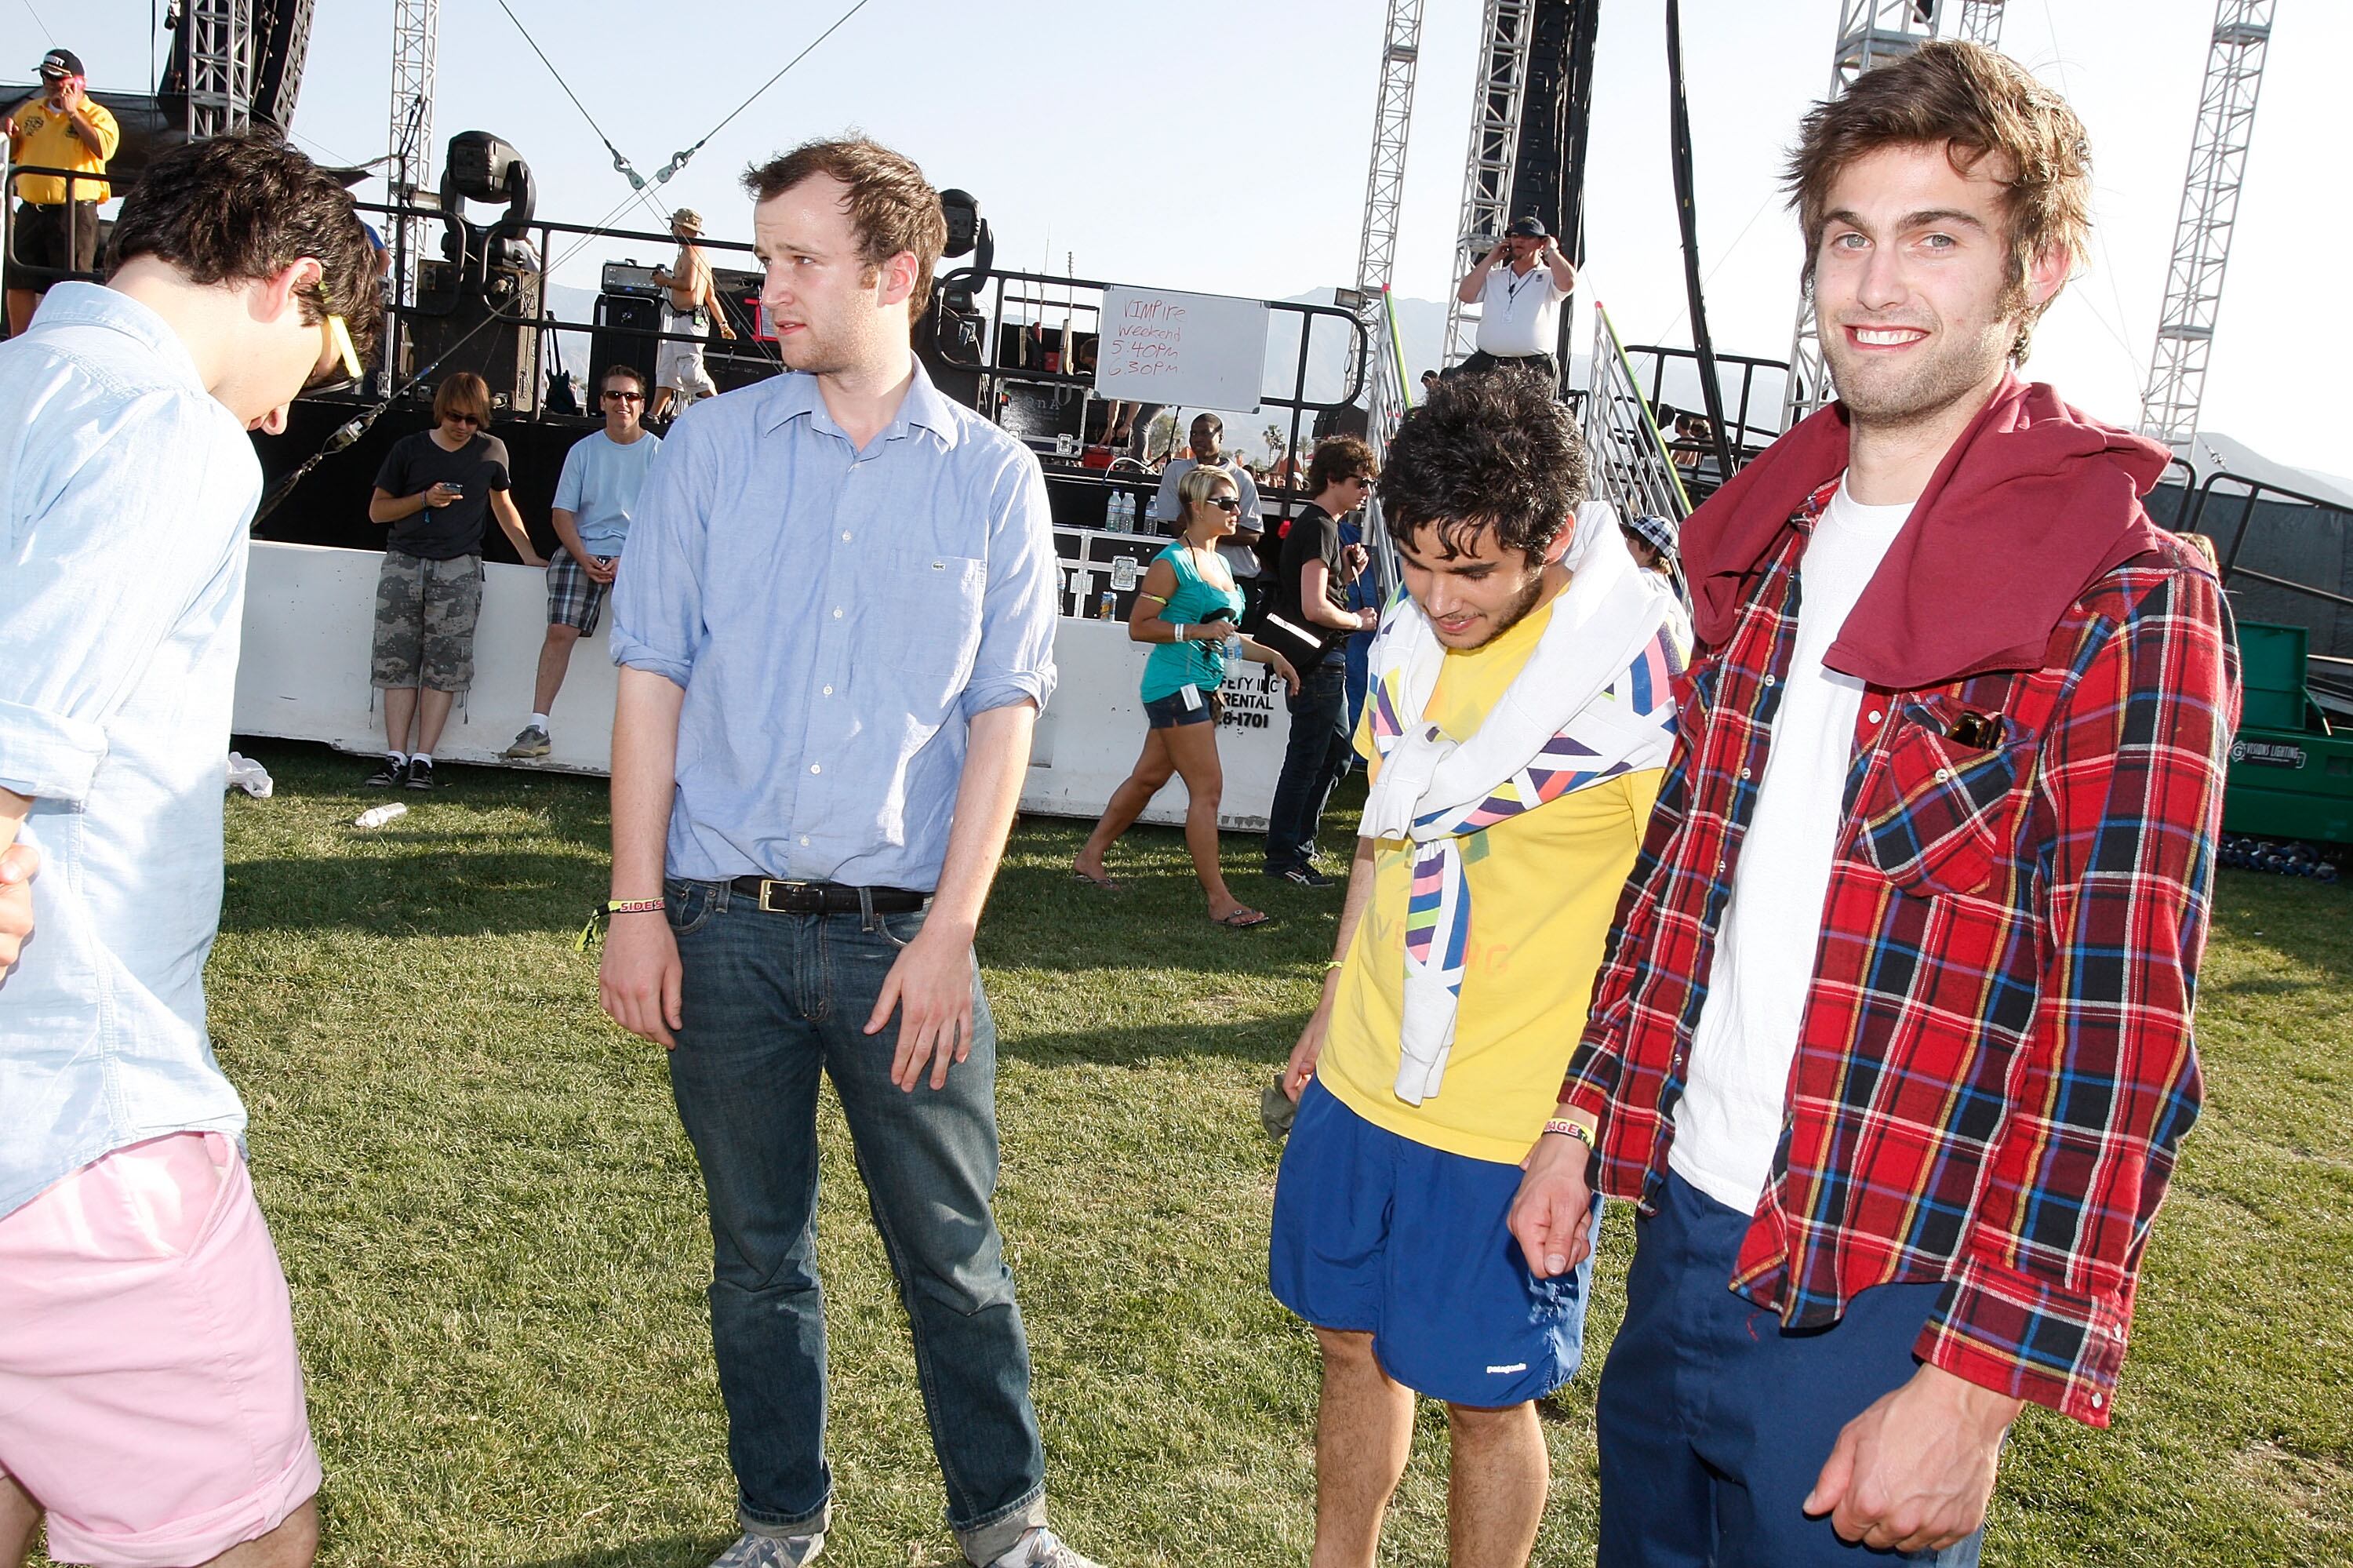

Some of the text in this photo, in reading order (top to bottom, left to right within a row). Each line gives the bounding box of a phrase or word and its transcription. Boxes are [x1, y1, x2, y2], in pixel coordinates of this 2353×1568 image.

[1223, 693, 1274, 710] RENTAL
[1219, 711, 1268, 728] 8-1701
[2246, 743, 2270, 756] VISIONS
[2271, 745, 2299, 759] LIGHTING
[1544, 1121, 1579, 1136] AGE
